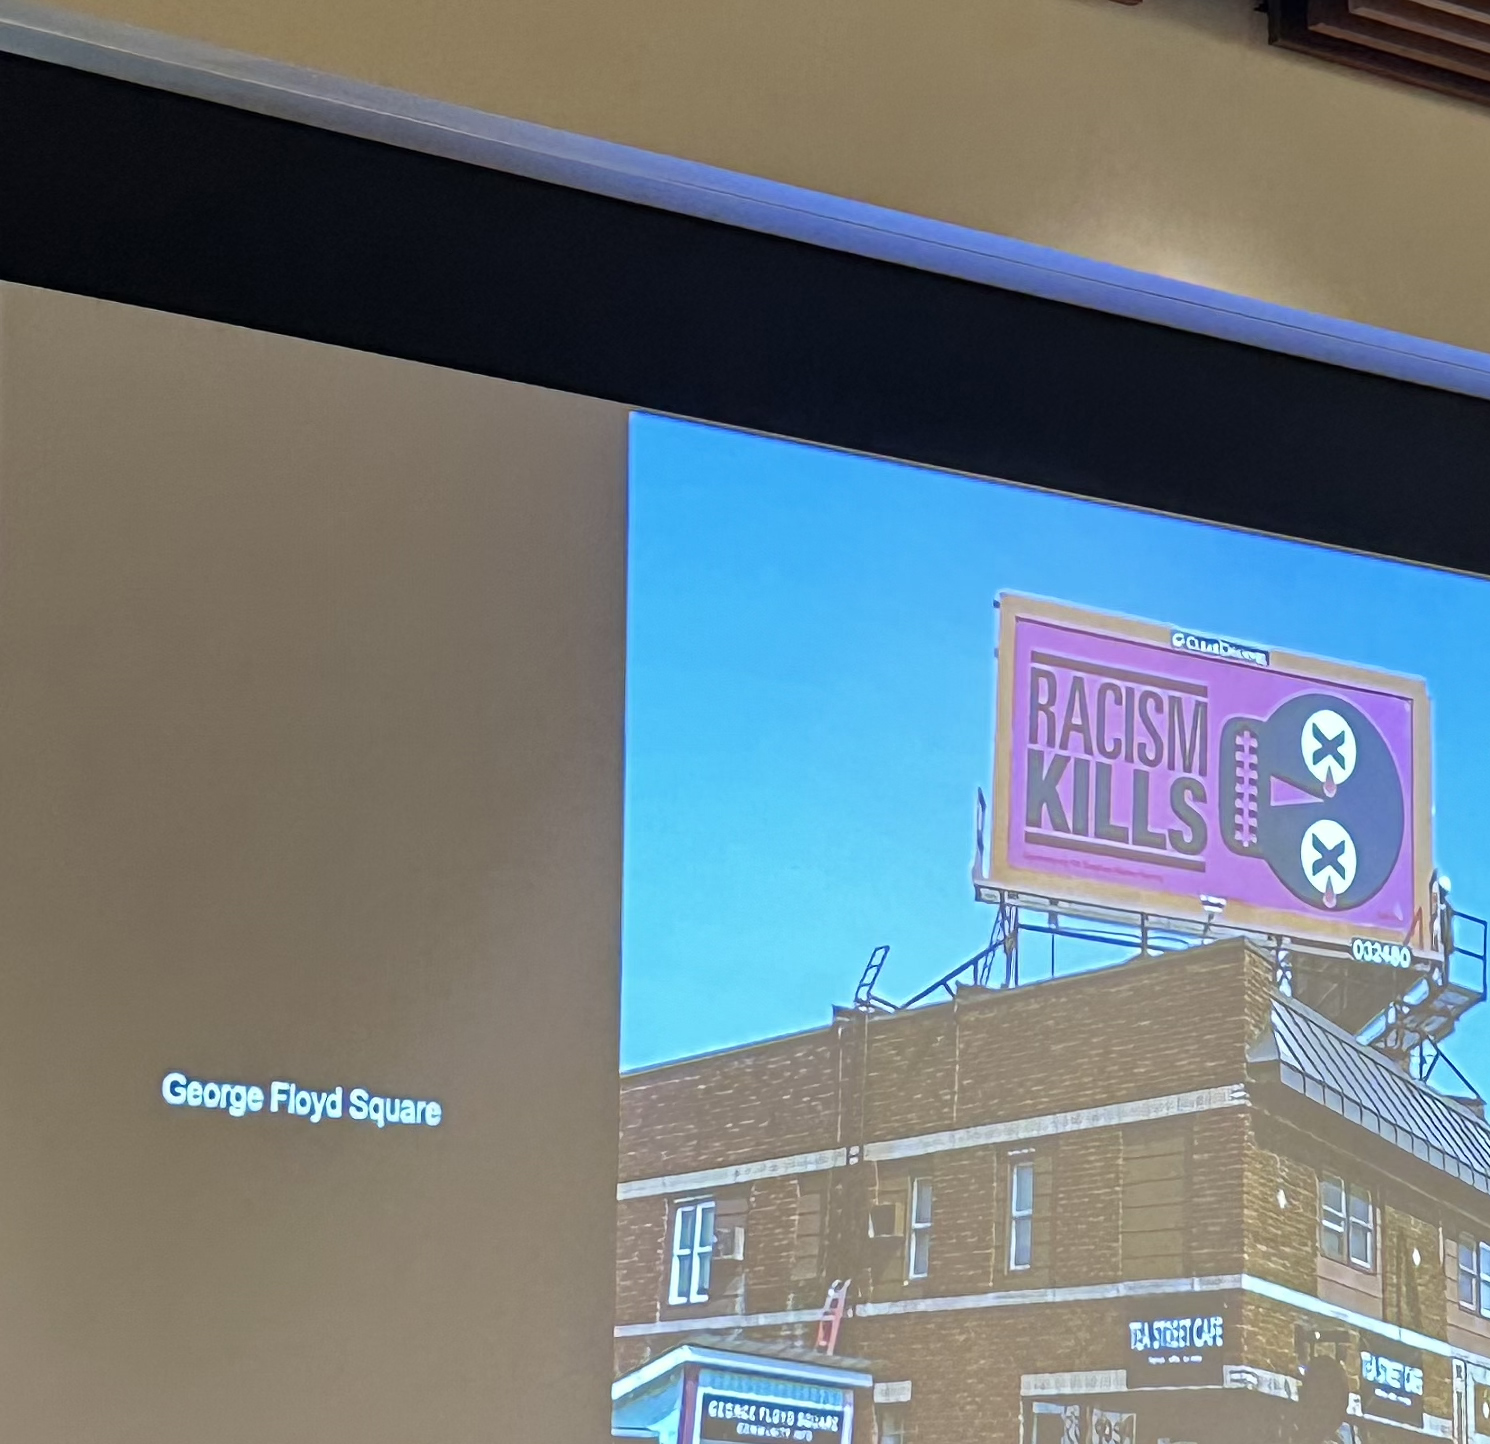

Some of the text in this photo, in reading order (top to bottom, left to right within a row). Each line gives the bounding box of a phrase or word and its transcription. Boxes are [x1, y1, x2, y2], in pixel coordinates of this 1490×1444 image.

[1028, 665, 1208, 778] RACISM
[1025, 747, 1208, 856] KILLS
[161, 1072, 442, 1129] George Floyd Square
